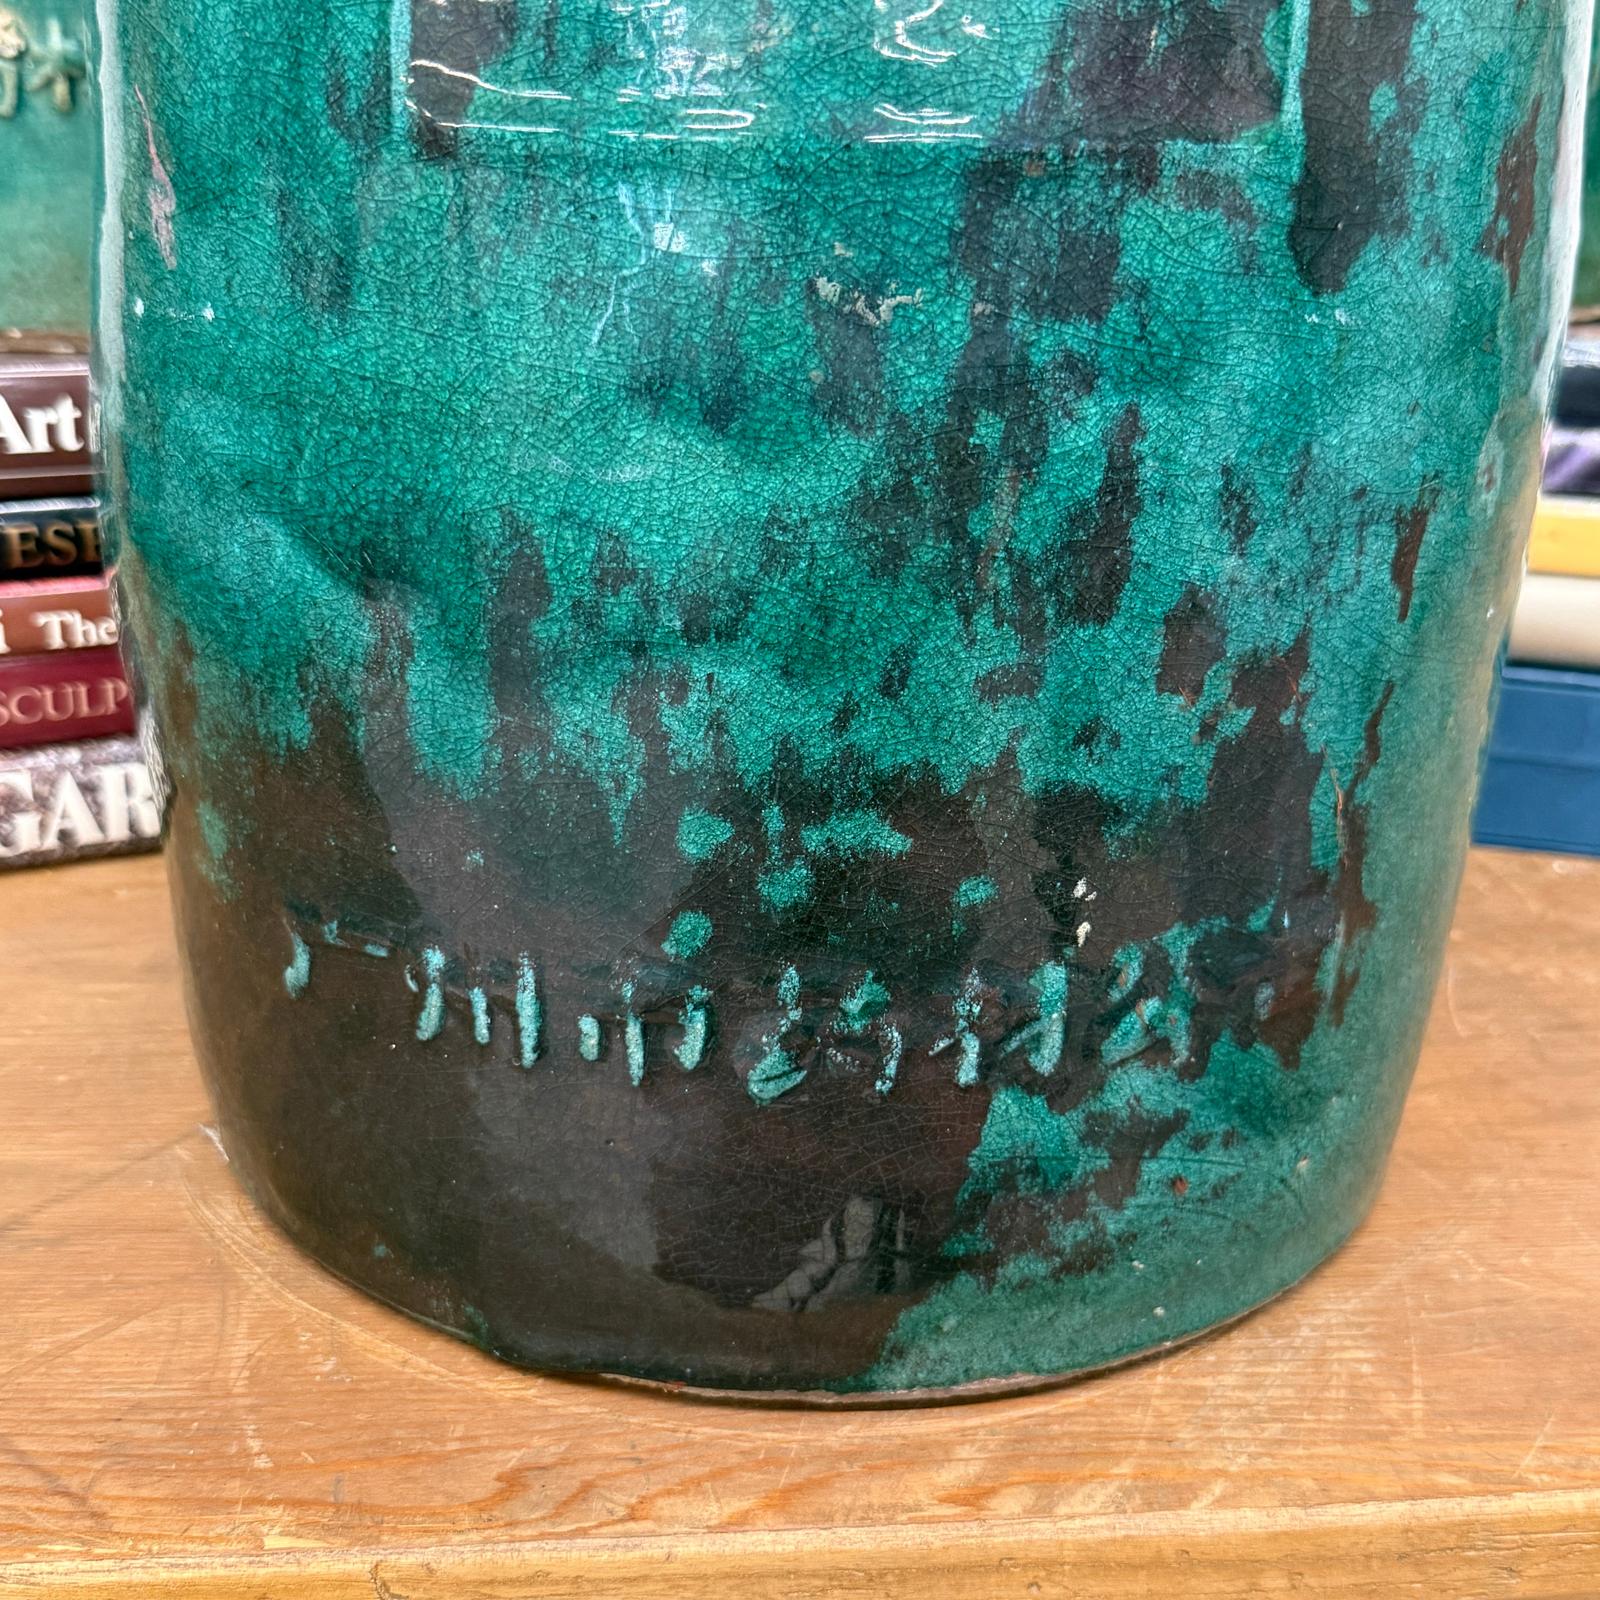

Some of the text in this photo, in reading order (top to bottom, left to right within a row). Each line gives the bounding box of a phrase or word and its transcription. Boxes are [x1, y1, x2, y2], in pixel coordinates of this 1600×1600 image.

[0, 393, 85, 454] Art
[31, 609, 119, 650] The
[0, 762, 161, 857] GAR
